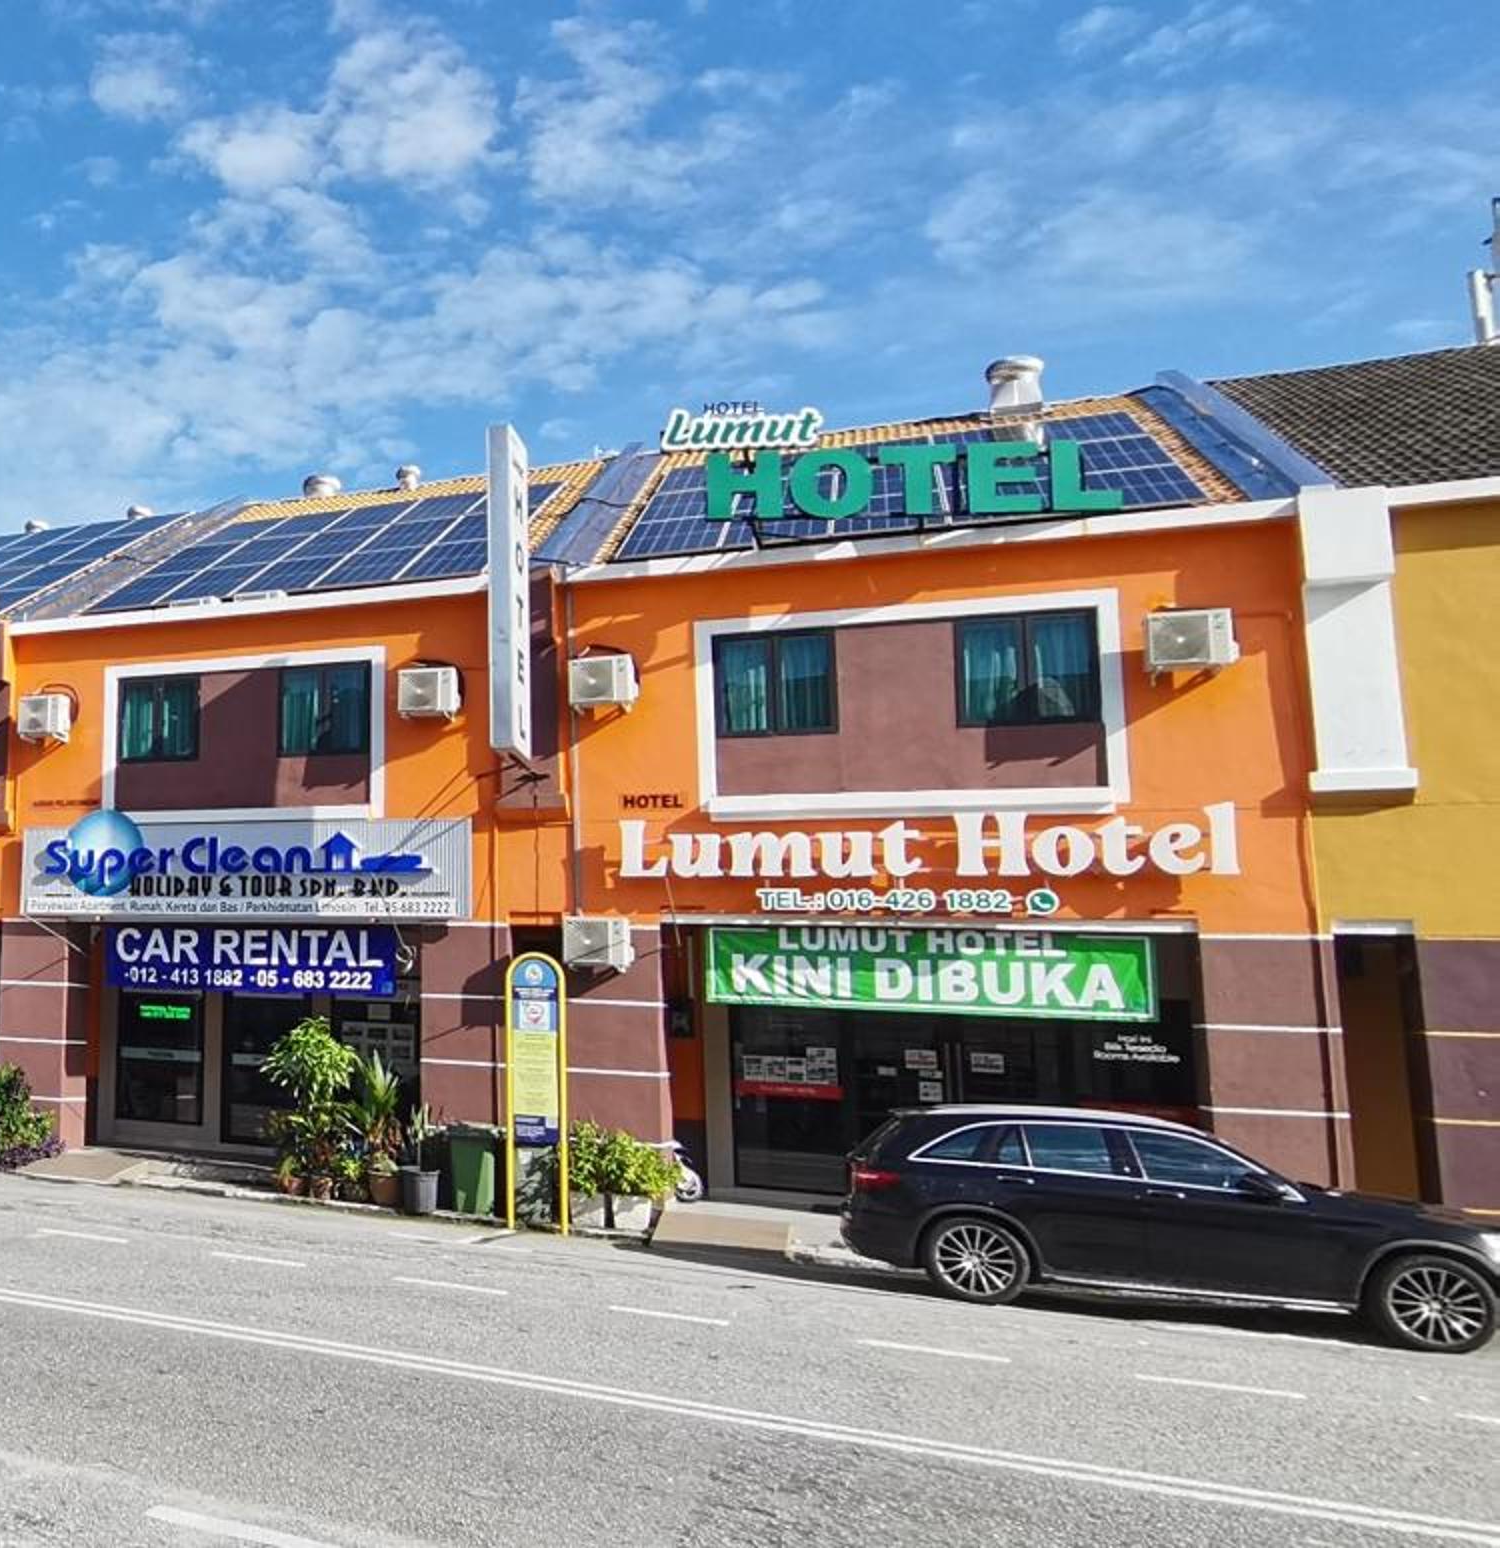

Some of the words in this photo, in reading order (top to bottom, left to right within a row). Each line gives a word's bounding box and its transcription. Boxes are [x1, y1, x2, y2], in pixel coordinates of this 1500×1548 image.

[703, 401, 764, 414] HOTEL
[664, 410, 820, 447] Lumut
[706, 440, 1124, 521] HOTEL
[512, 484, 526, 740] HOTEL
[622, 794, 684, 809] HOTEL
[618, 819, 922, 878] Lumut
[953, 801, 1241, 876] Hotel
[128, 876, 213, 898] HOLIDAY
[238, 876, 293, 897] TOUR
[945, 890, 1009, 909] 1882
[423, 902, 450, 913] 2222
[116, 928, 198, 963] CAR
[213, 929, 384, 967] RENTAL
[778, 928, 912, 952] LUMUT
[928, 929, 1067, 957] HOTEL
[170, 968, 198, 984] 413
[205, 969, 242, 986] 1882
[293, 971, 324, 988] 683
[329, 972, 372, 989] 2222
[731, 952, 852, 998] KINI
[874, 957, 1125, 1009] DIBUKA
